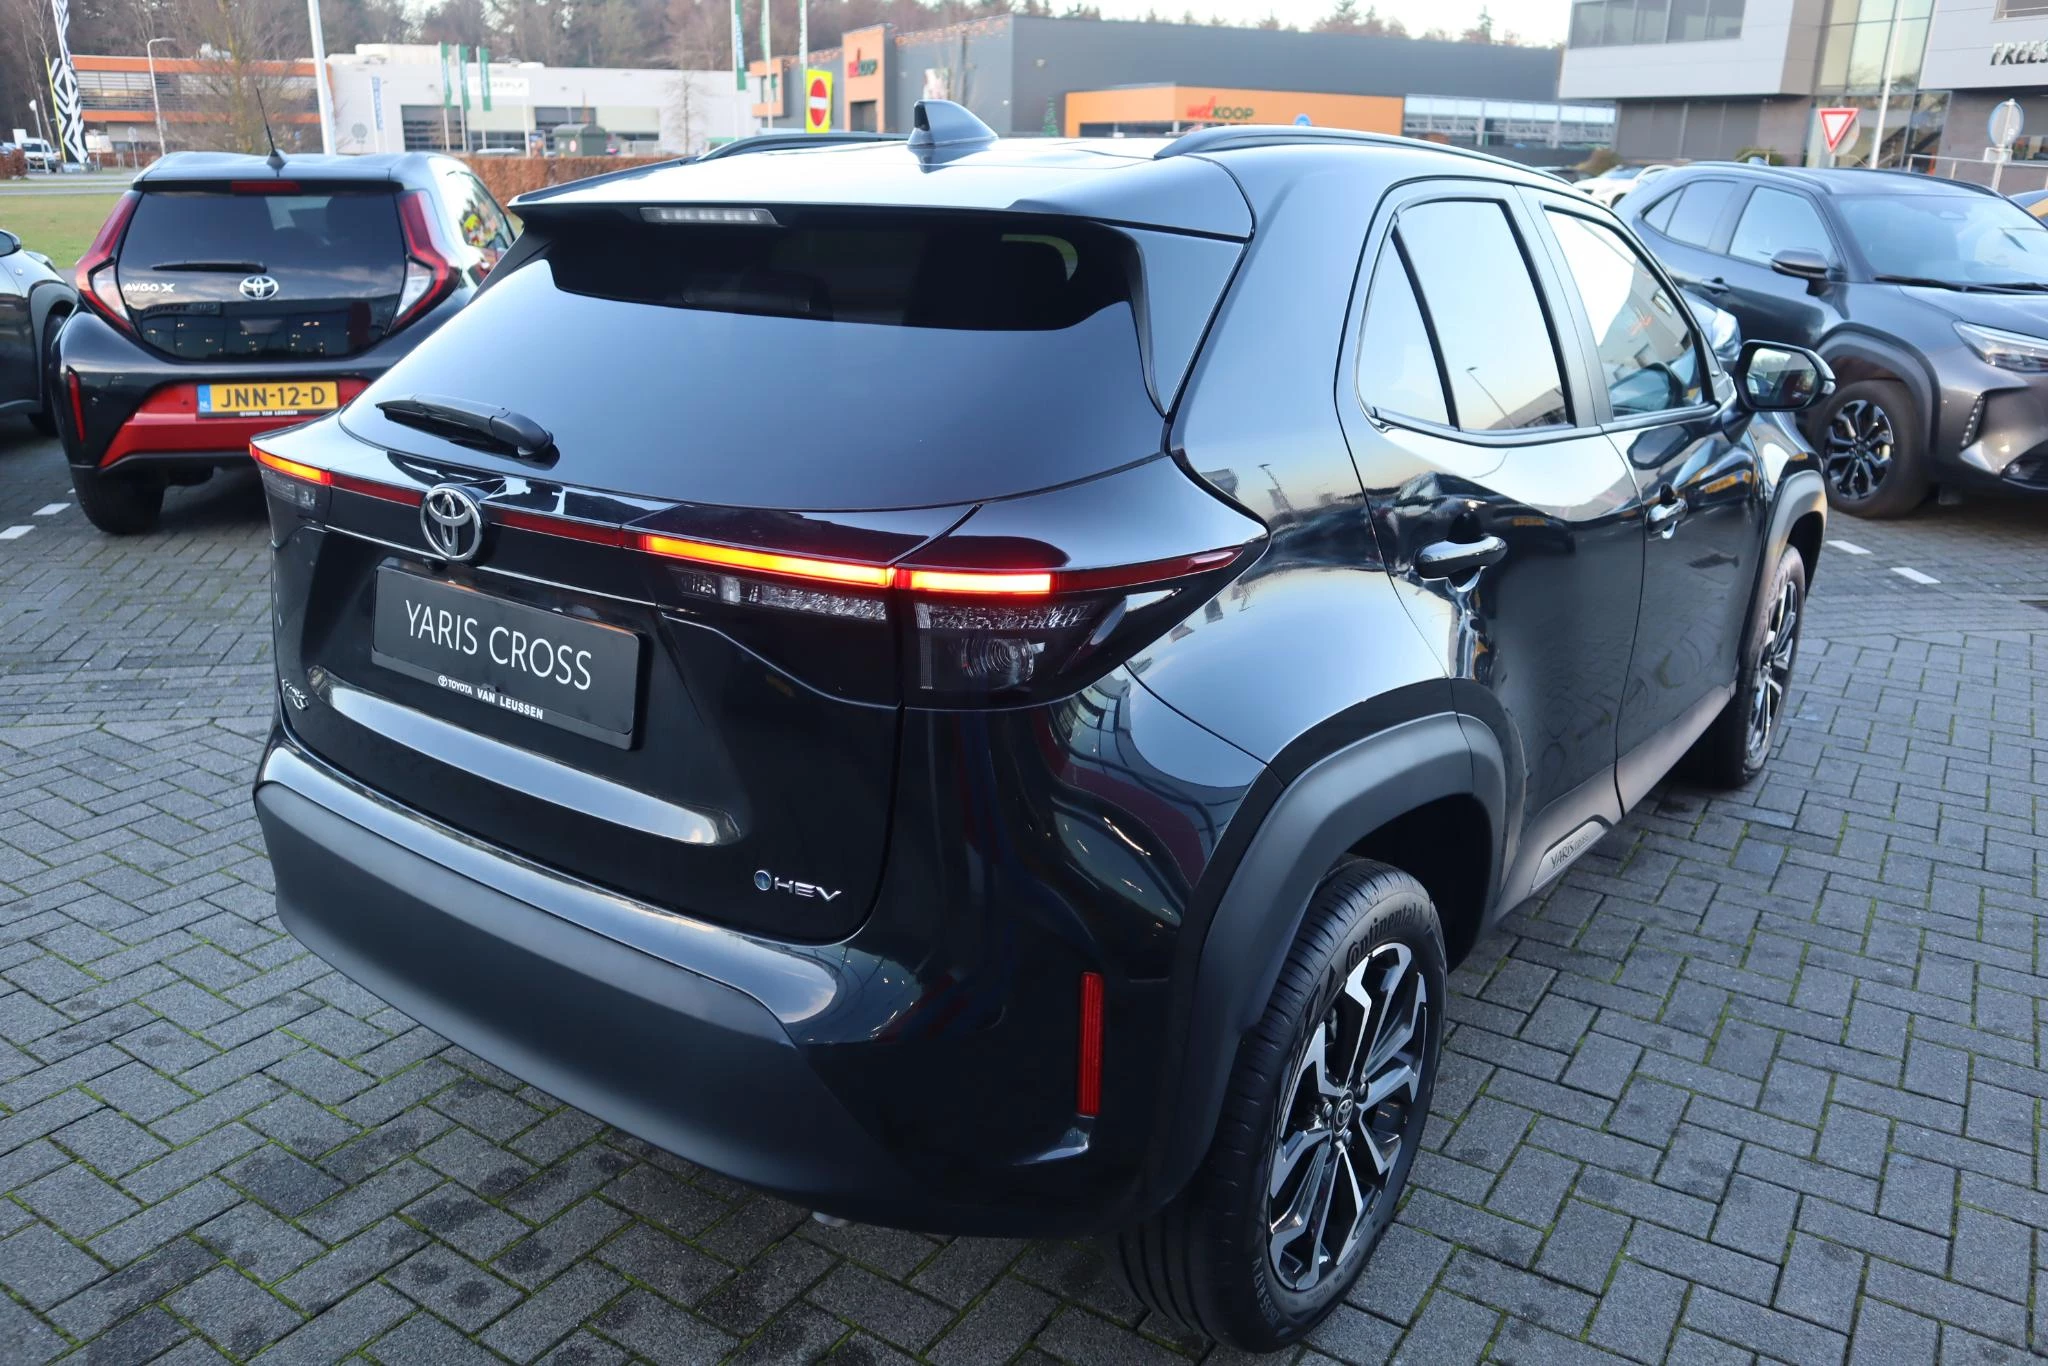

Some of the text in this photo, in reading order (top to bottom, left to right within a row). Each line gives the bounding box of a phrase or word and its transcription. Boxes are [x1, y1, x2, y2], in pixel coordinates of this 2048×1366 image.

[221, 385, 326, 408] JNN-12-D
[405, 599, 592, 690] YARIS CROSS
[447, 678, 544, 720] TOYOTA VAN LEUSSEN
[774, 876, 842, 901] HEV
[1346, 902, 1417, 972] Continental
